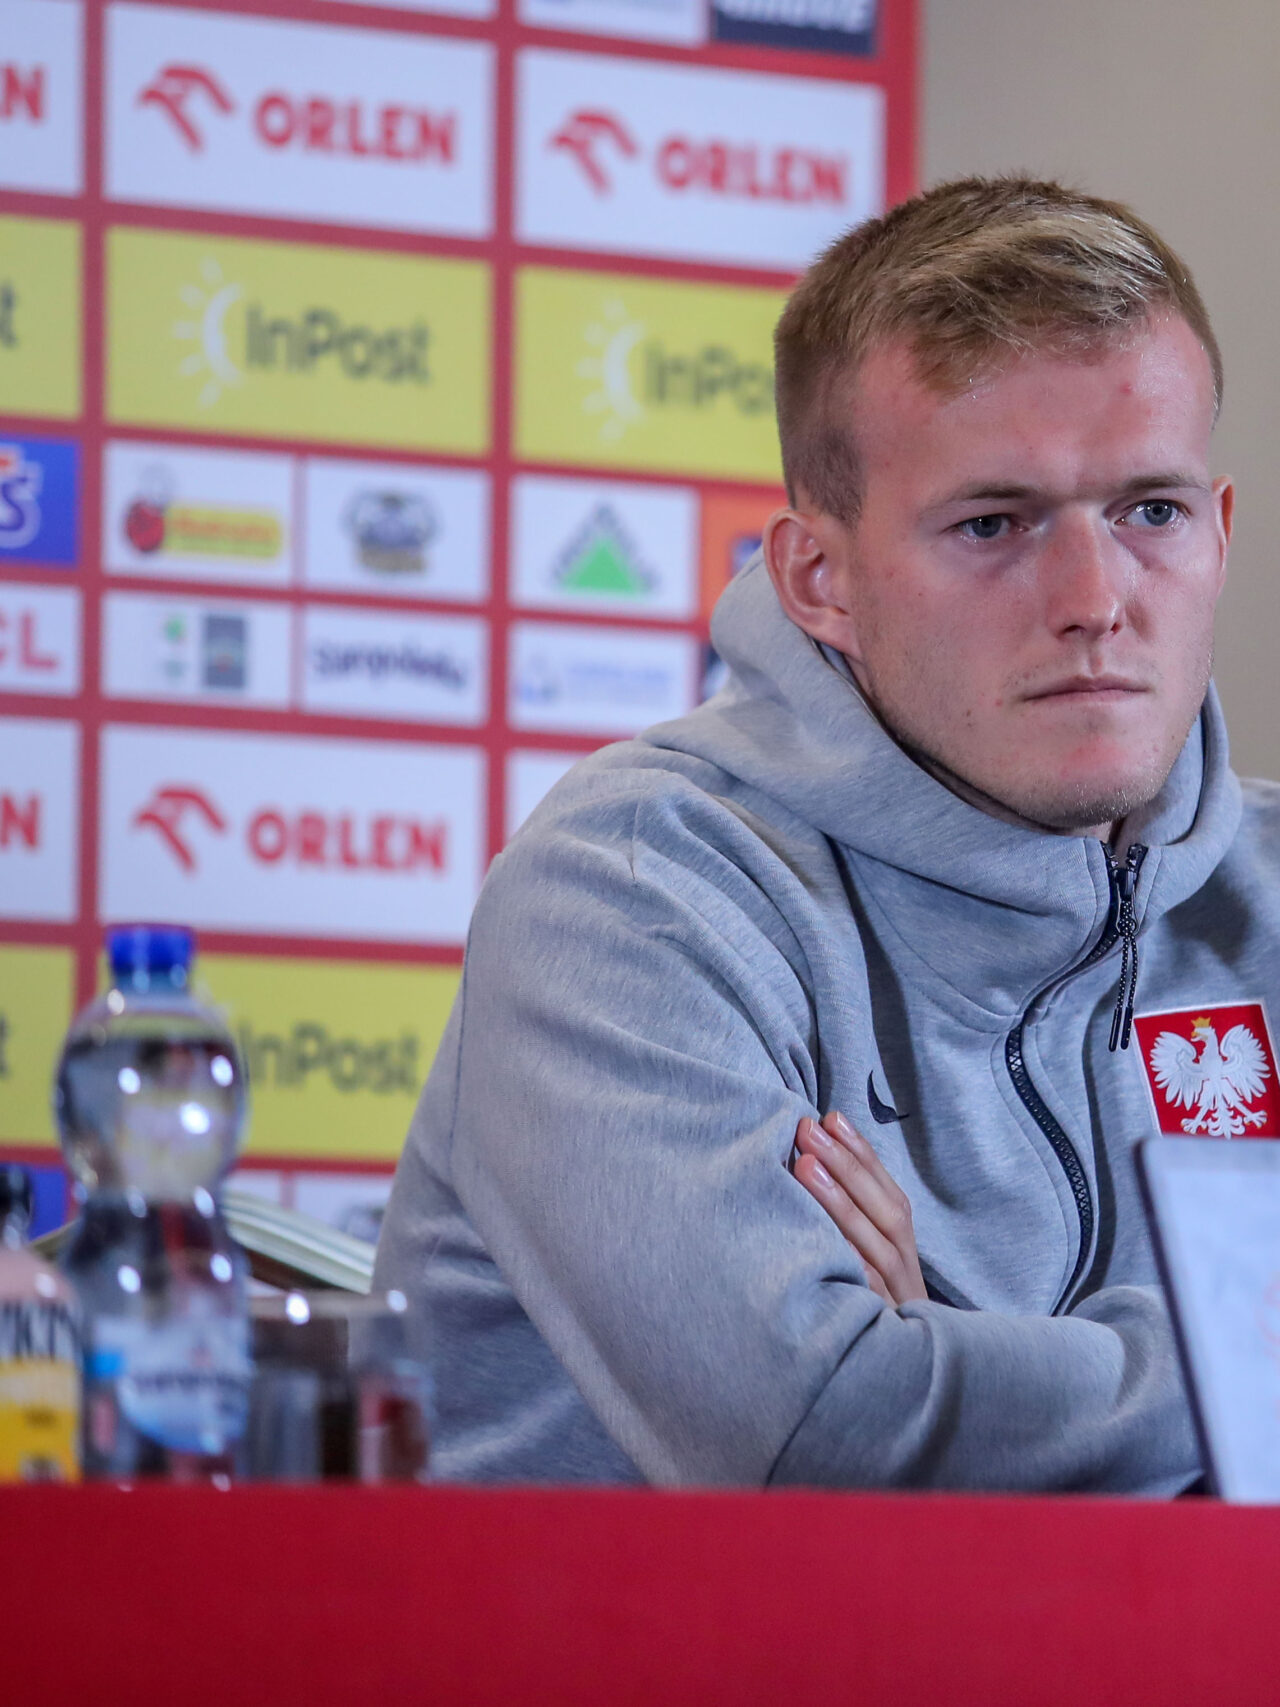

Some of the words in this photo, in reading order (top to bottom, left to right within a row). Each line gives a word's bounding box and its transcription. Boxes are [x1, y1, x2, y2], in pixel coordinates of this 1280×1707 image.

[255, 95, 457, 163] ORLEN
[655, 136, 849, 205] ORLEN
[246, 303, 432, 382] InPost
[645, 338, 775, 418] InPo
[248, 810, 447, 873] ORLEN
[241, 1016, 419, 1094] InPost
